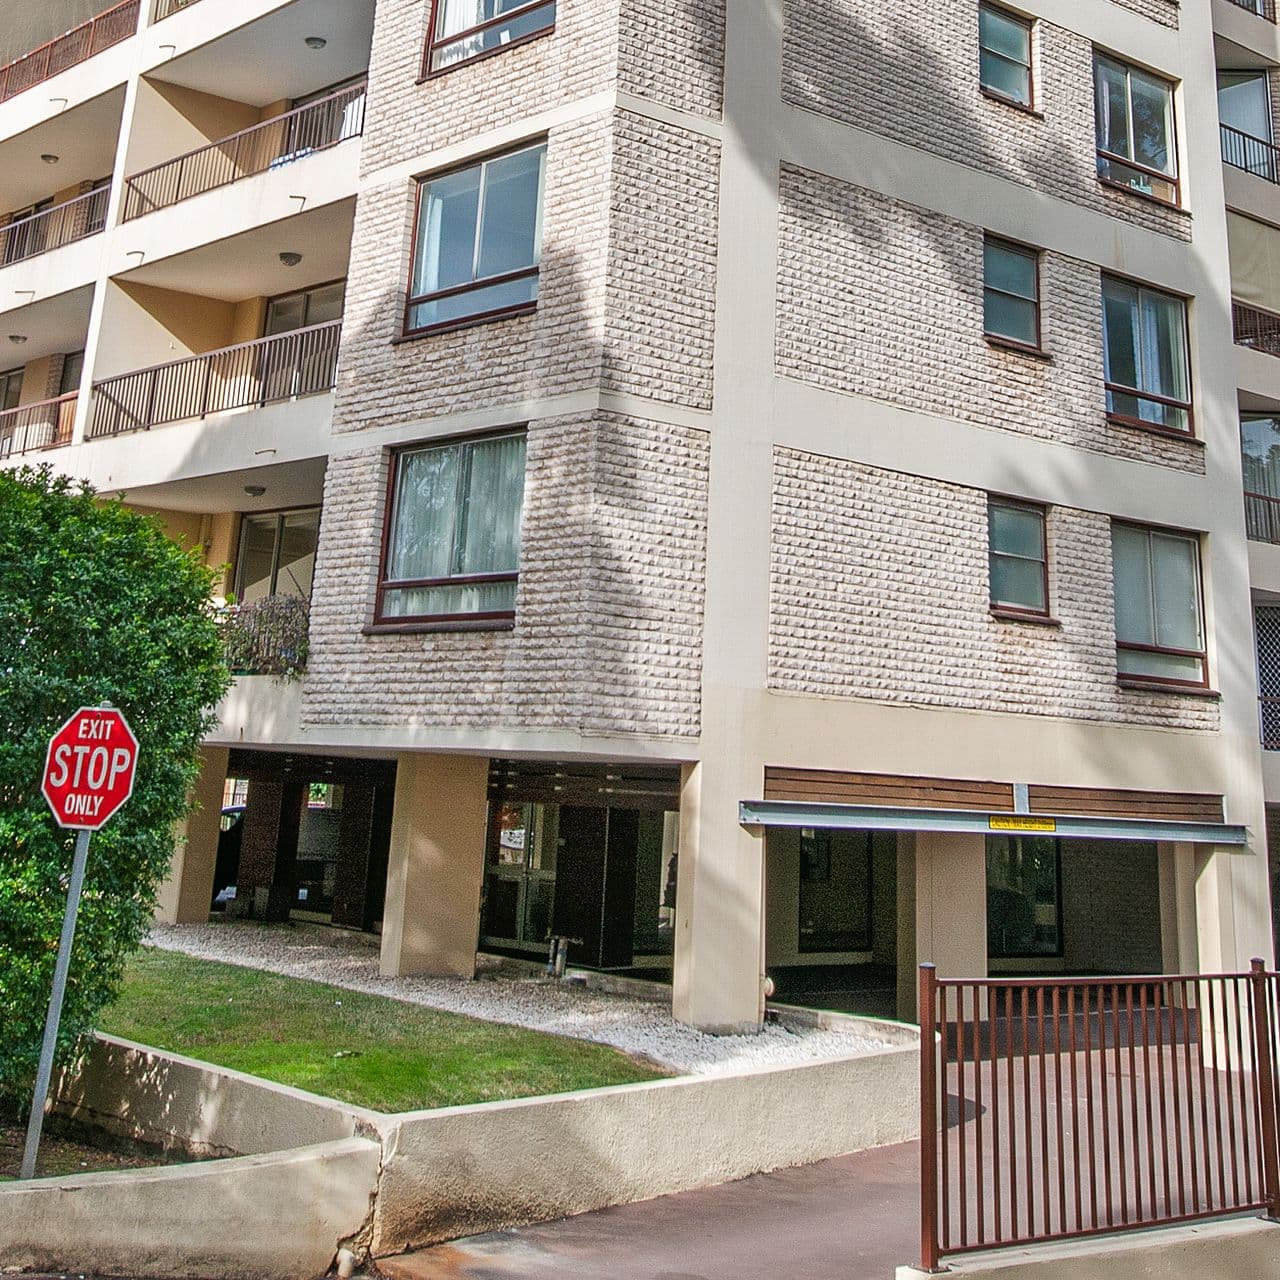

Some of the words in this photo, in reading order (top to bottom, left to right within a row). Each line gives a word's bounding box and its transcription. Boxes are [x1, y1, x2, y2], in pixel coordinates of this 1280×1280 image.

[78, 718, 115, 740] EXIT
[49, 743, 131, 791] STOP
[64, 793, 104, 816] ONLY
